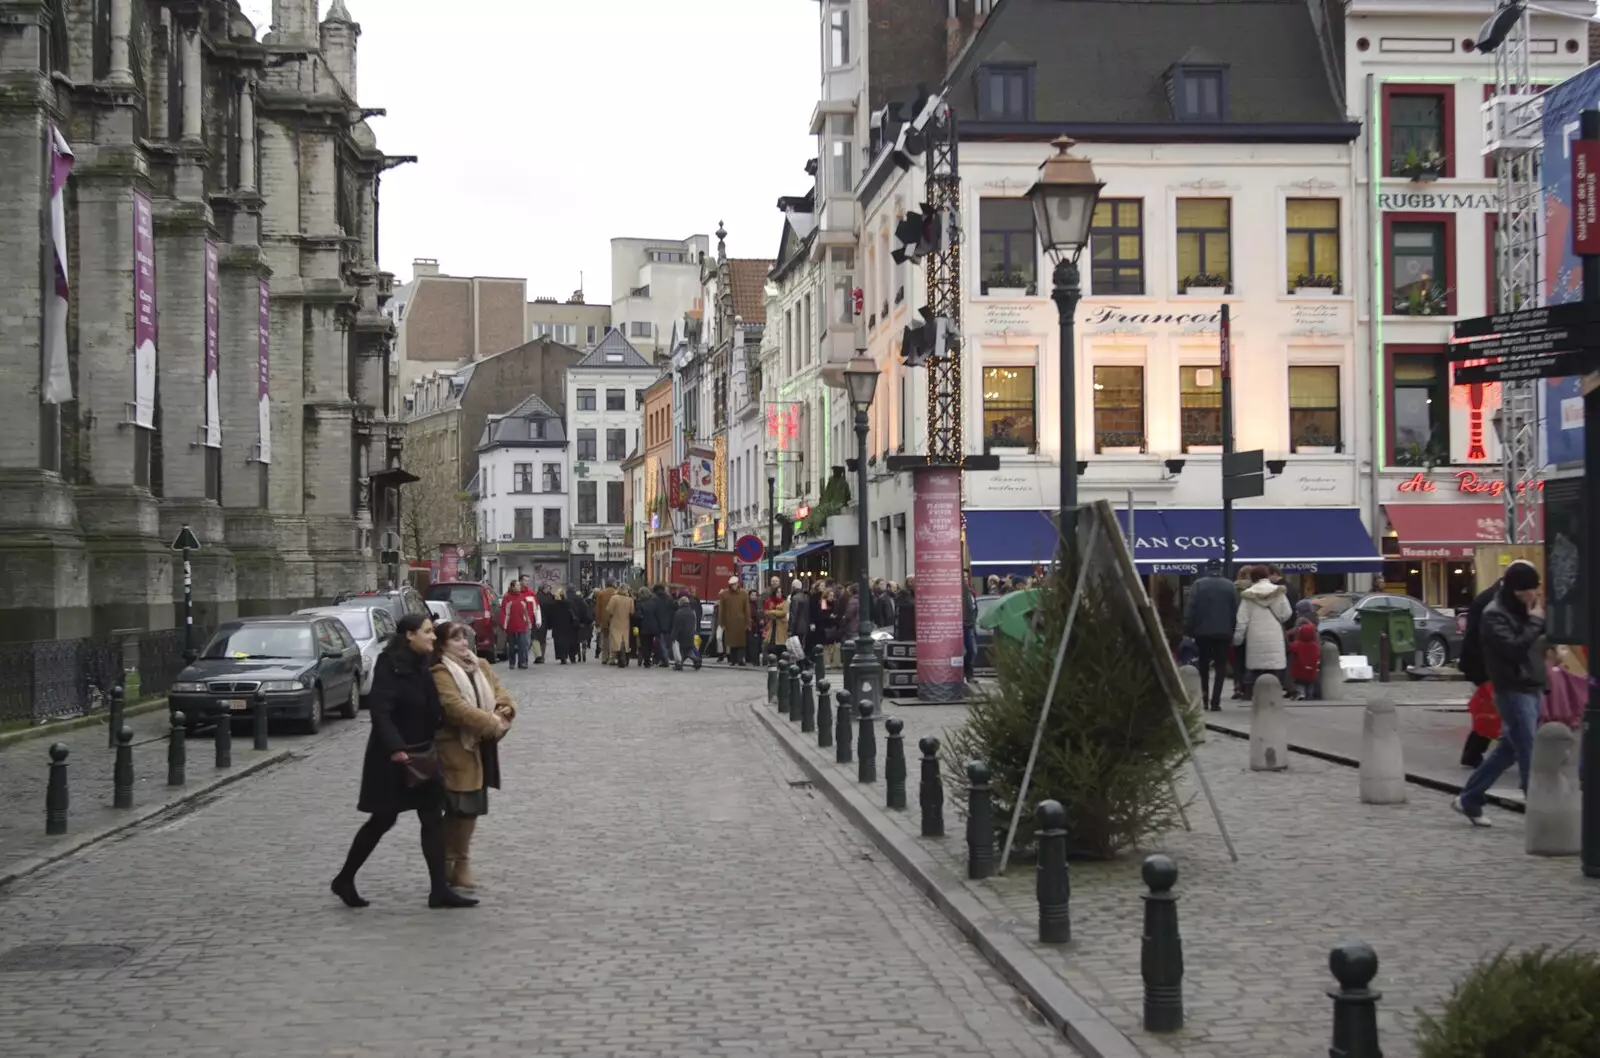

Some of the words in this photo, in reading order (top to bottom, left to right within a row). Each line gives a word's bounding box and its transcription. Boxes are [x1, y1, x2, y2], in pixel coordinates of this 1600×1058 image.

[1085, 304, 1239, 325] Françoi
[1398, 472, 1438, 493] Au
[1153, 563, 1198, 574] FRANÇOIS
